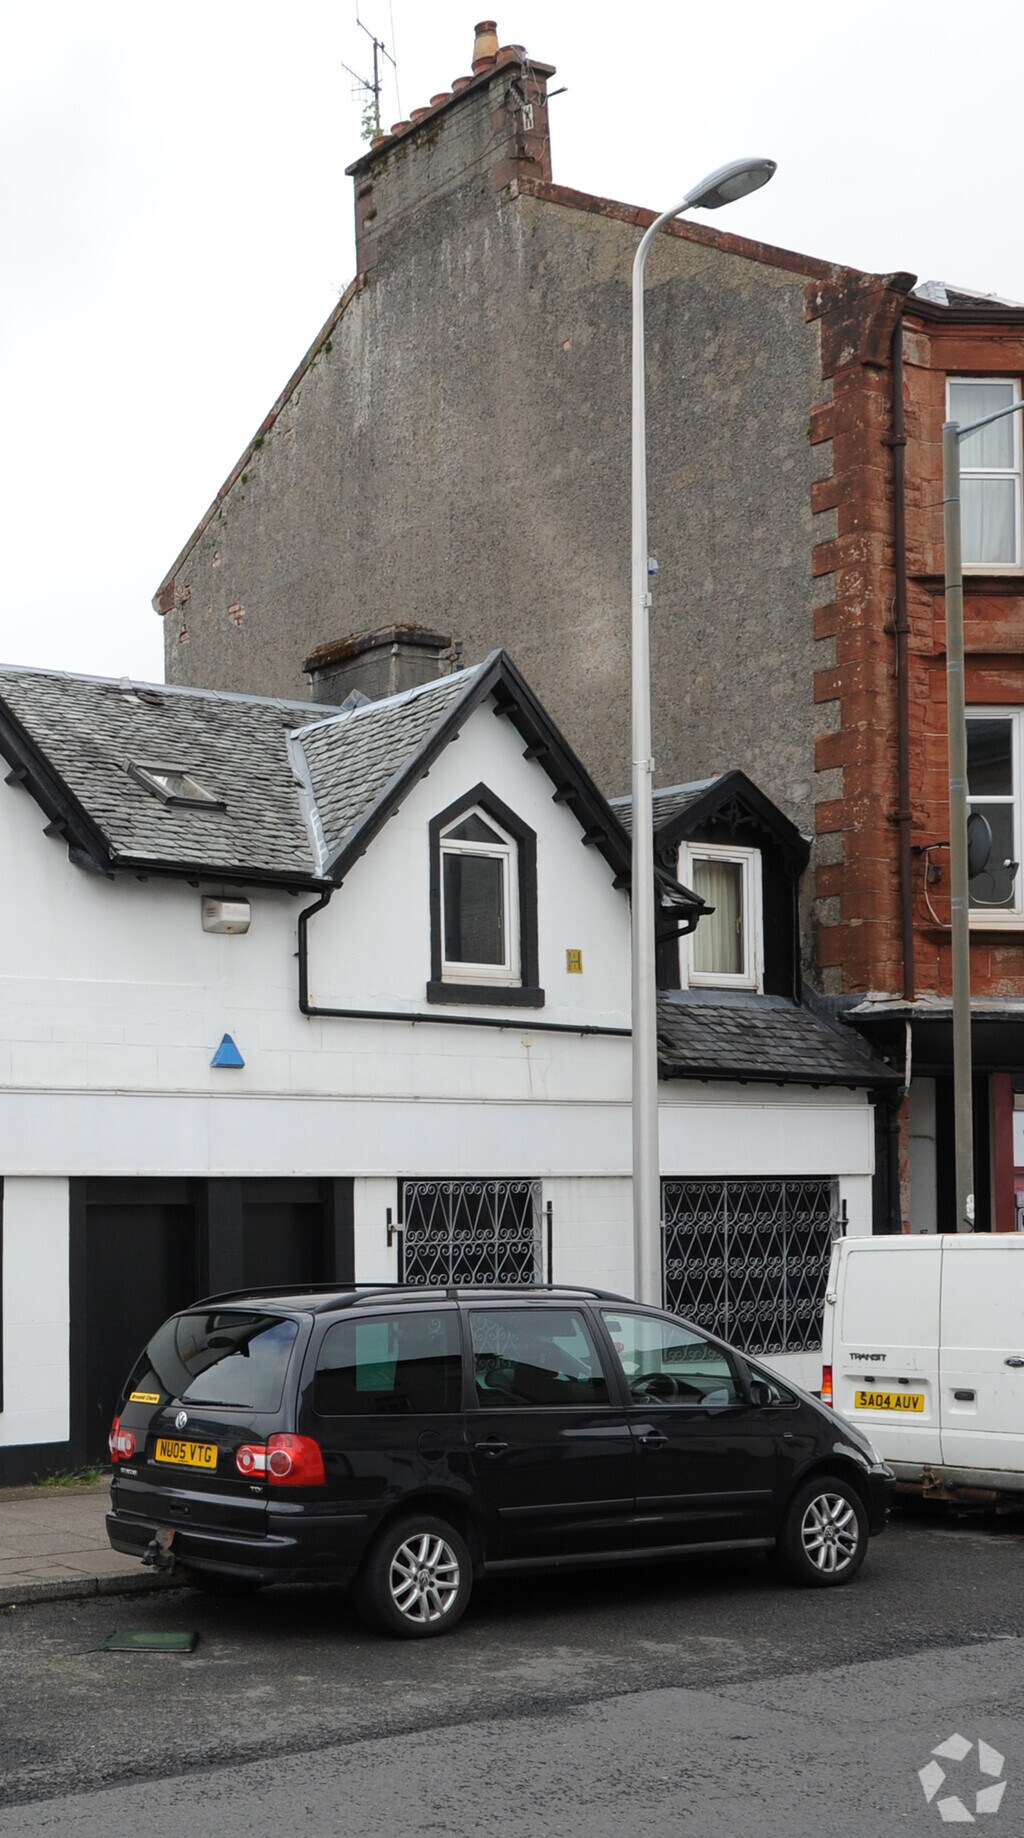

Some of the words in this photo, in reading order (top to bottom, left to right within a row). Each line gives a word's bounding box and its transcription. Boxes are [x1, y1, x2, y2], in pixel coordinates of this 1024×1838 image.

[849, 1352, 886, 1362] TRANSIT
[860, 1394, 891, 1408] SA04
[895, 1396, 919, 1409] AUV
[160, 1440, 186, 1458] NU05
[189, 1444, 213, 1463] VTG
